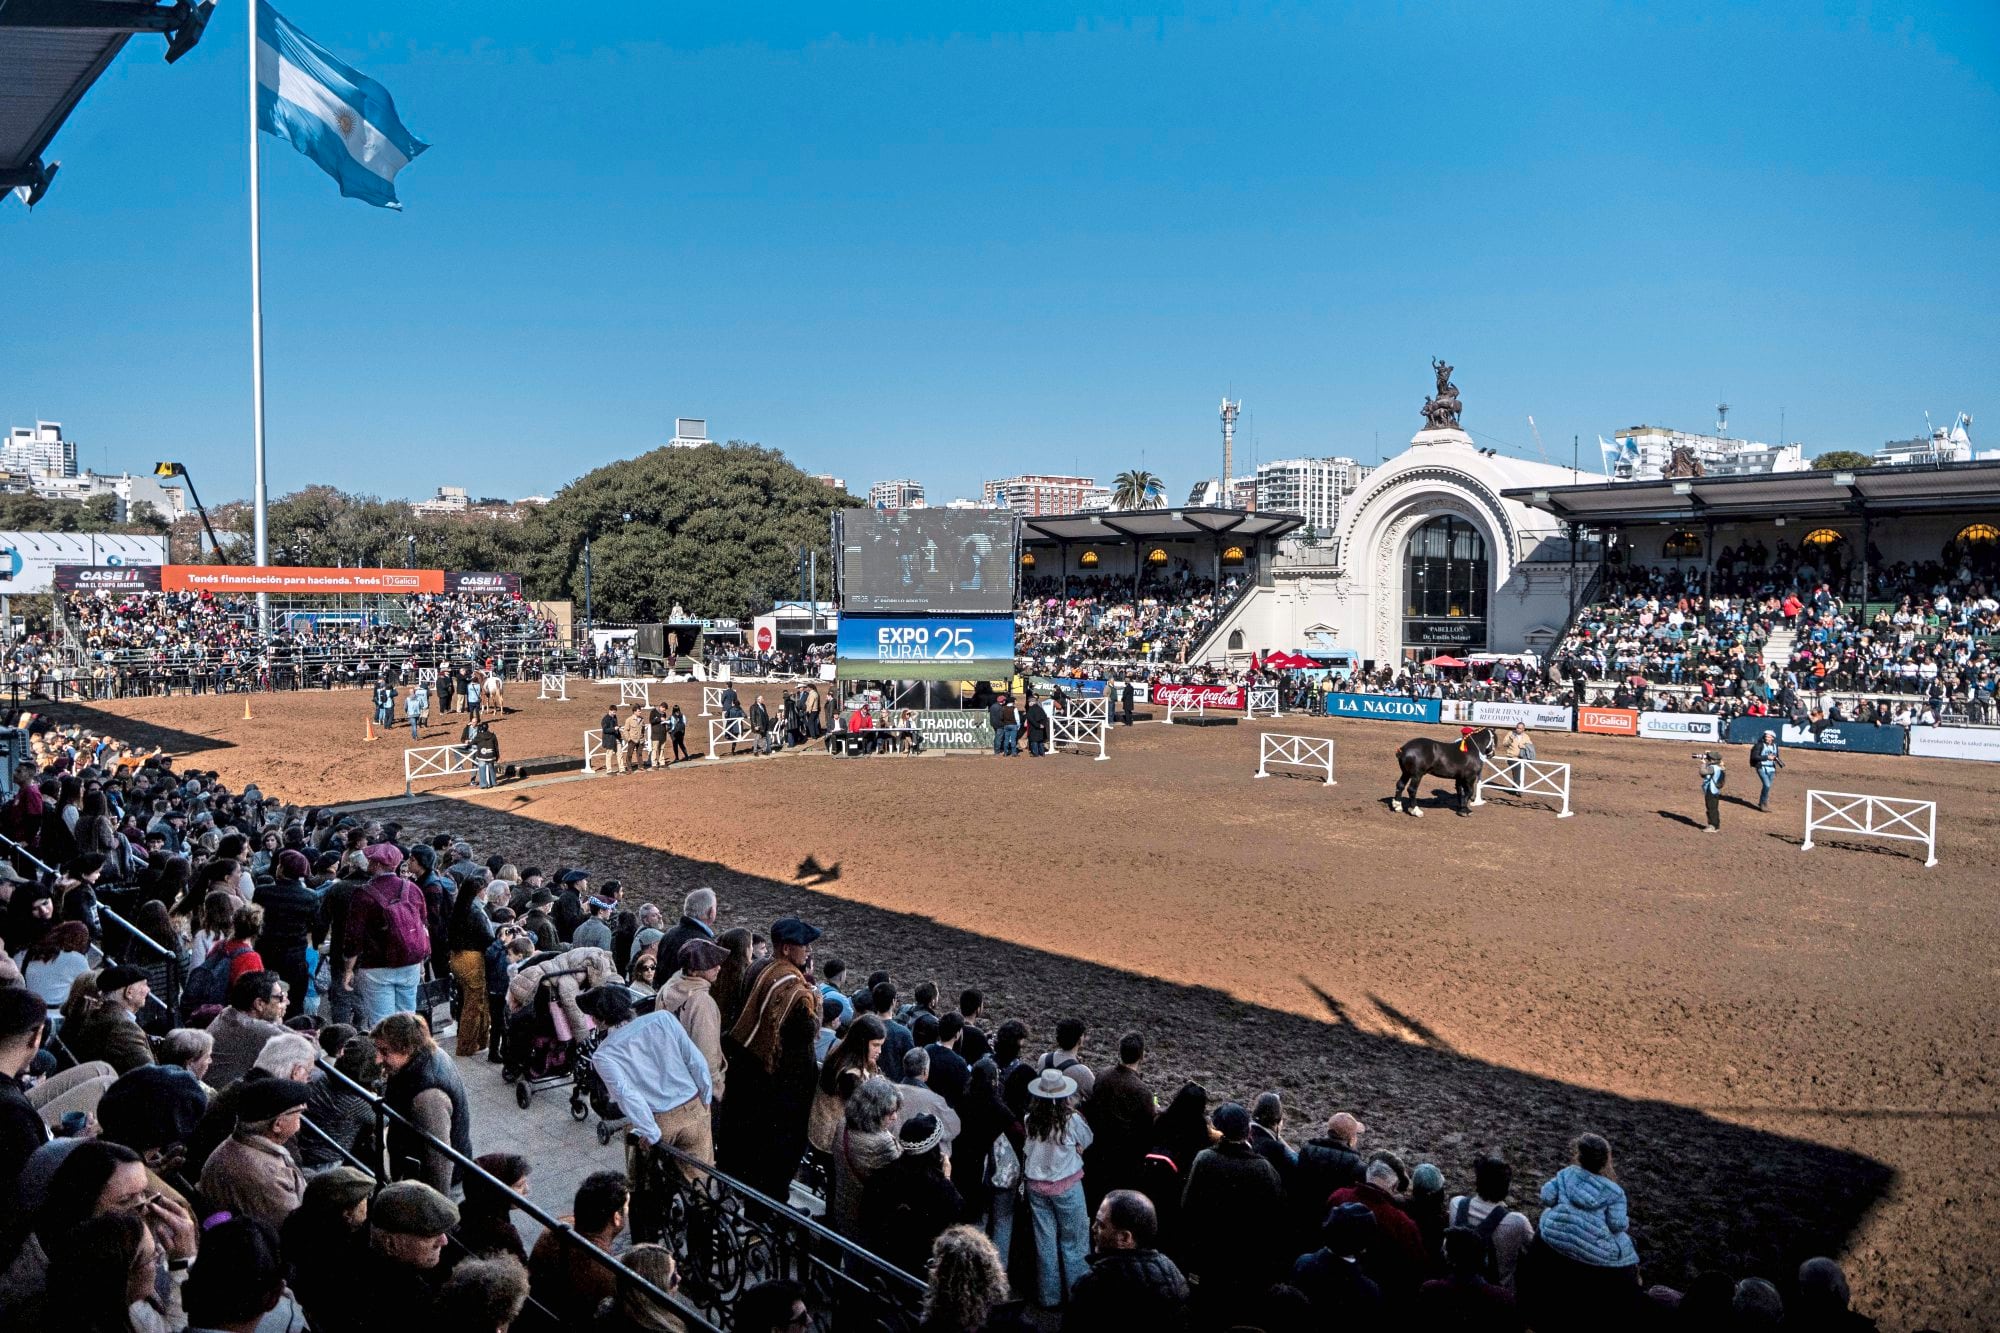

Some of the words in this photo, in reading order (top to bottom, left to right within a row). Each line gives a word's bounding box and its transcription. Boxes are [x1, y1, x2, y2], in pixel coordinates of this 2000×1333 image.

[80, 570, 123, 581] CASE
[188, 574, 219, 583] Tenés
[221, 574, 282, 584] financiación
[284, 576, 306, 586] para
[308, 576, 352, 585] hacienda.
[354, 576, 380, 585] Tenés
[394, 577, 417, 585] Galicia
[460, 576, 492, 585] CASE
[716, 620, 729, 628] TV
[878, 627, 929, 644] EXPO
[934, 627, 975, 660] 25
[878, 644, 934, 660] RURAL
[1338, 699, 1359, 711] LA
[1363, 700, 1427, 716] NACION
[1537, 713, 1566, 723] Imperial
[1600, 716, 1628, 726] Galicia
[1648, 718, 1687, 731] chacra
[1690, 723, 1703, 732] TV
[922, 732, 976, 743] FUTURO.
[1821, 737, 1846, 745] Ciudad
